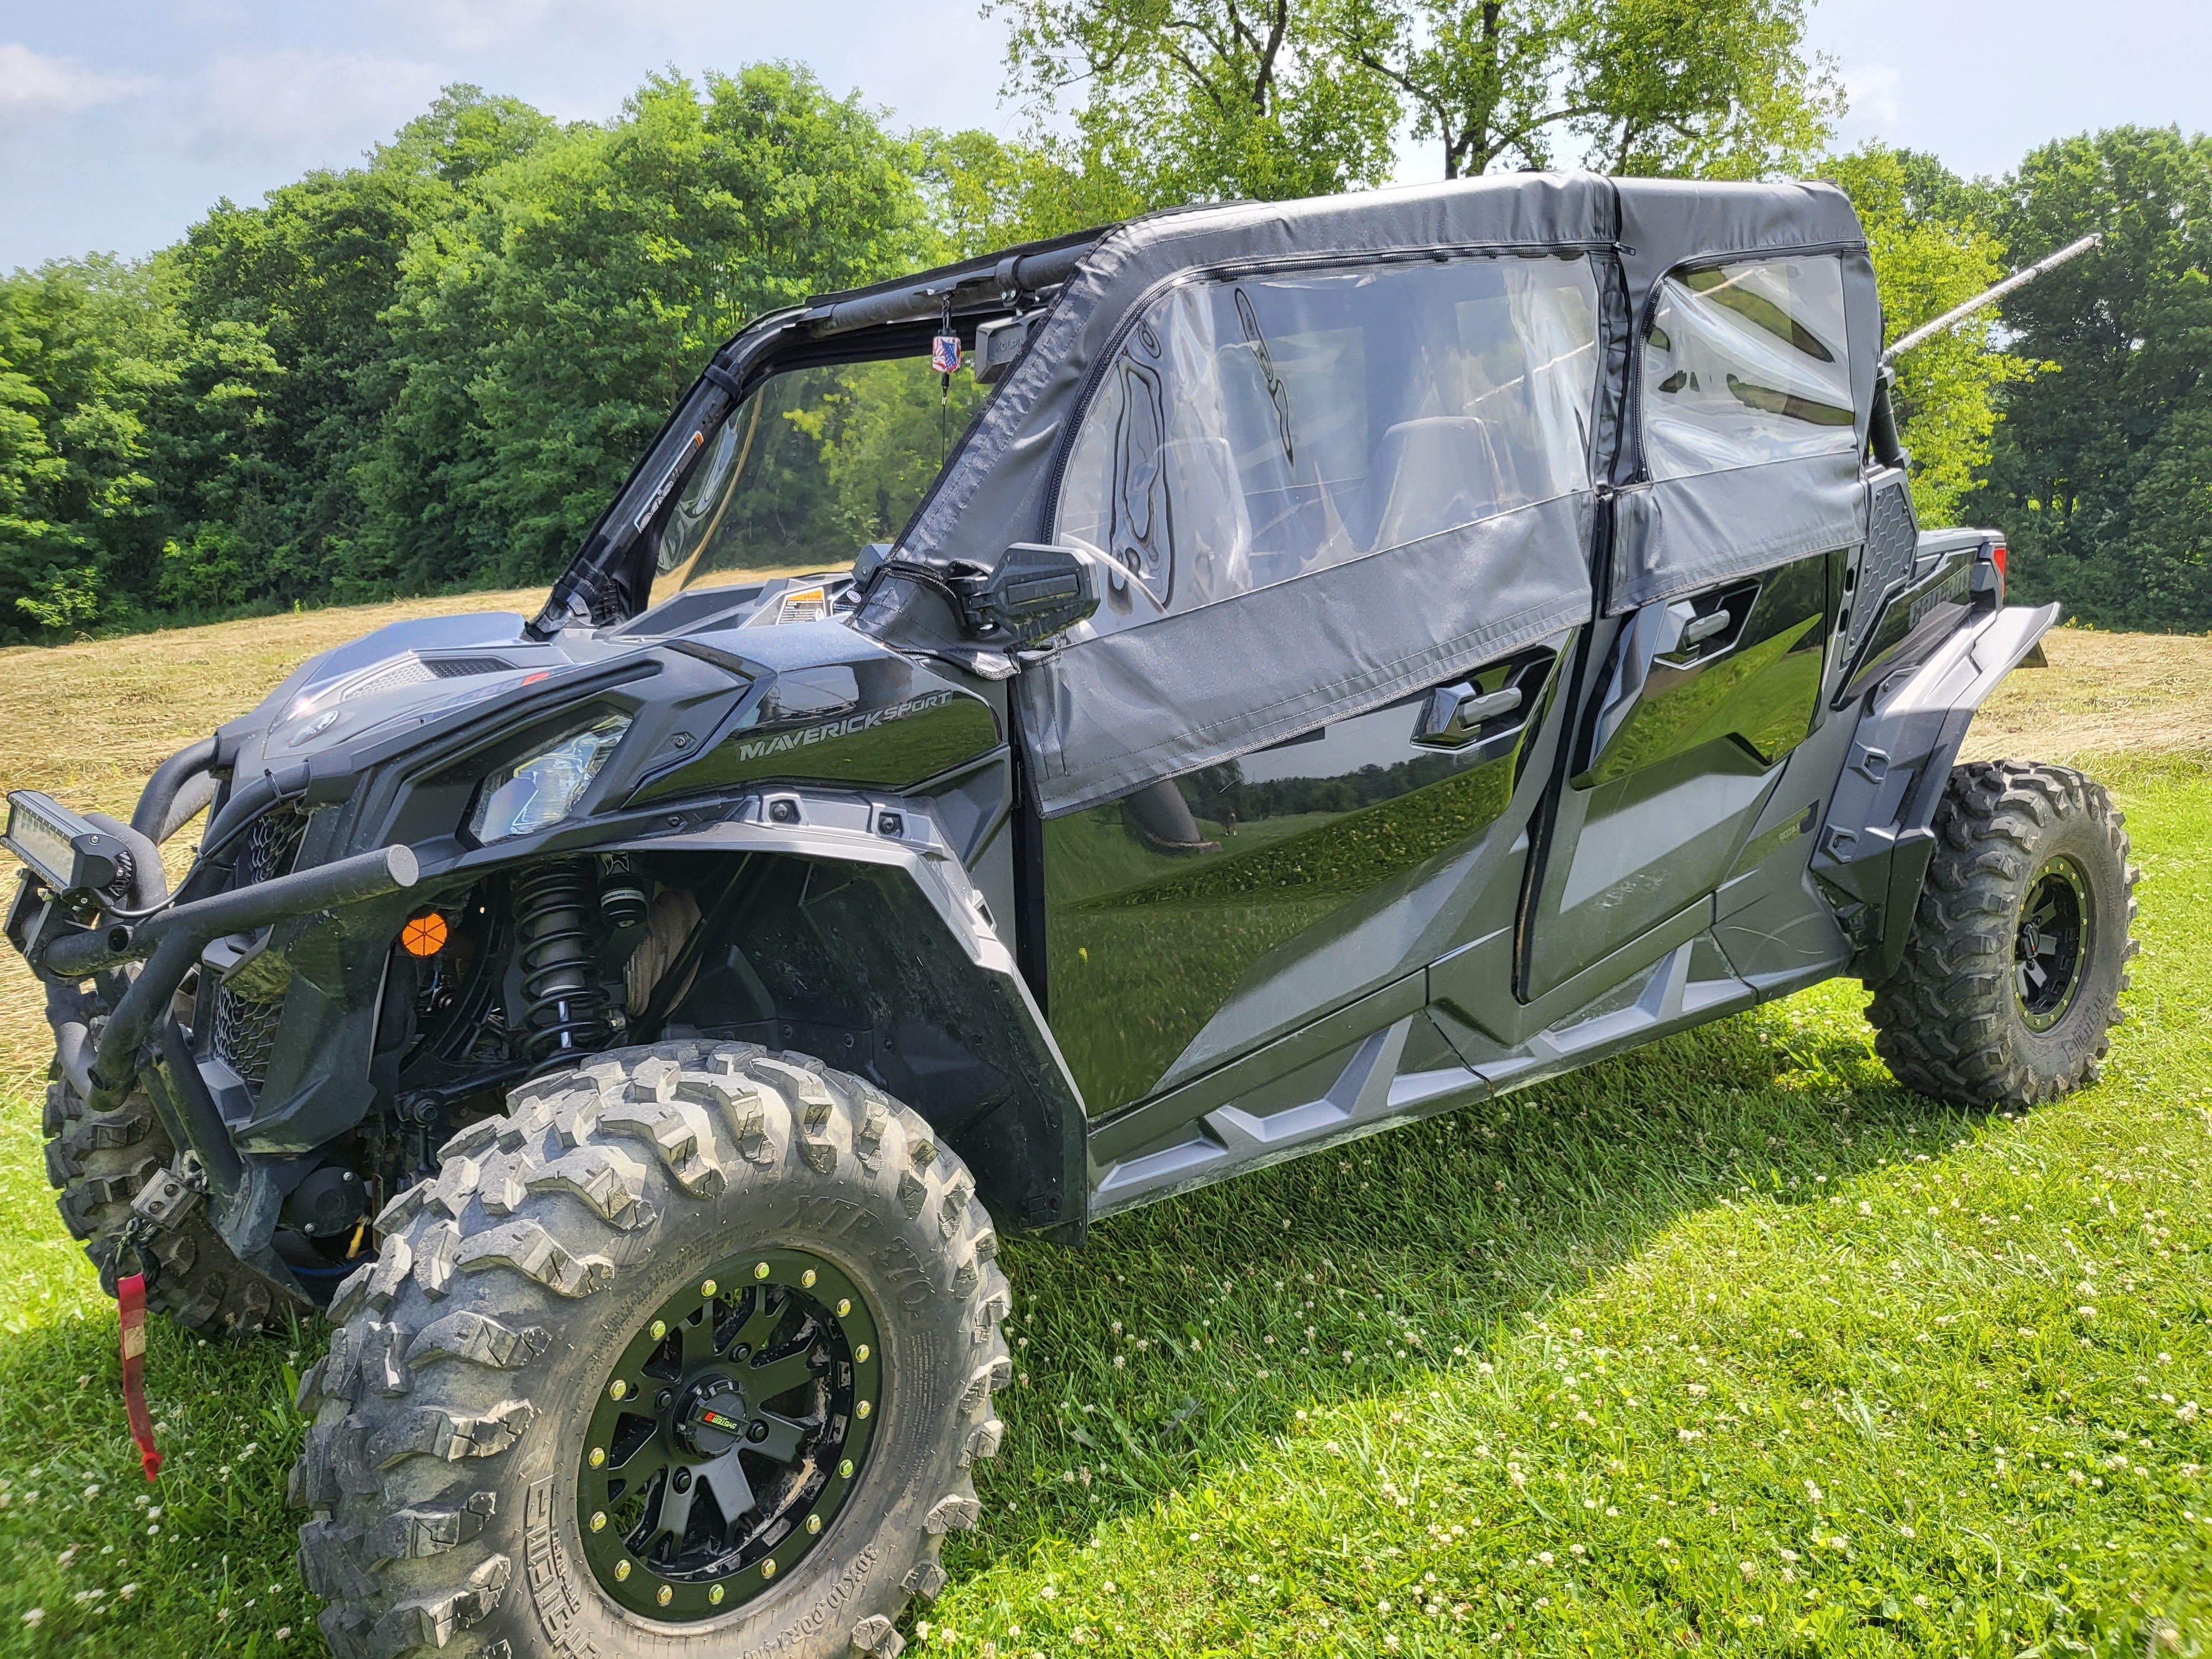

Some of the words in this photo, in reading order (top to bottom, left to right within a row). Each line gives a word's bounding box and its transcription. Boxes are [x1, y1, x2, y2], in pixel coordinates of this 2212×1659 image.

[739, 710, 883, 762] MAVERICK
[883, 691, 951, 721] SPORT
[711, 1417, 737, 1430] SYSTEM
